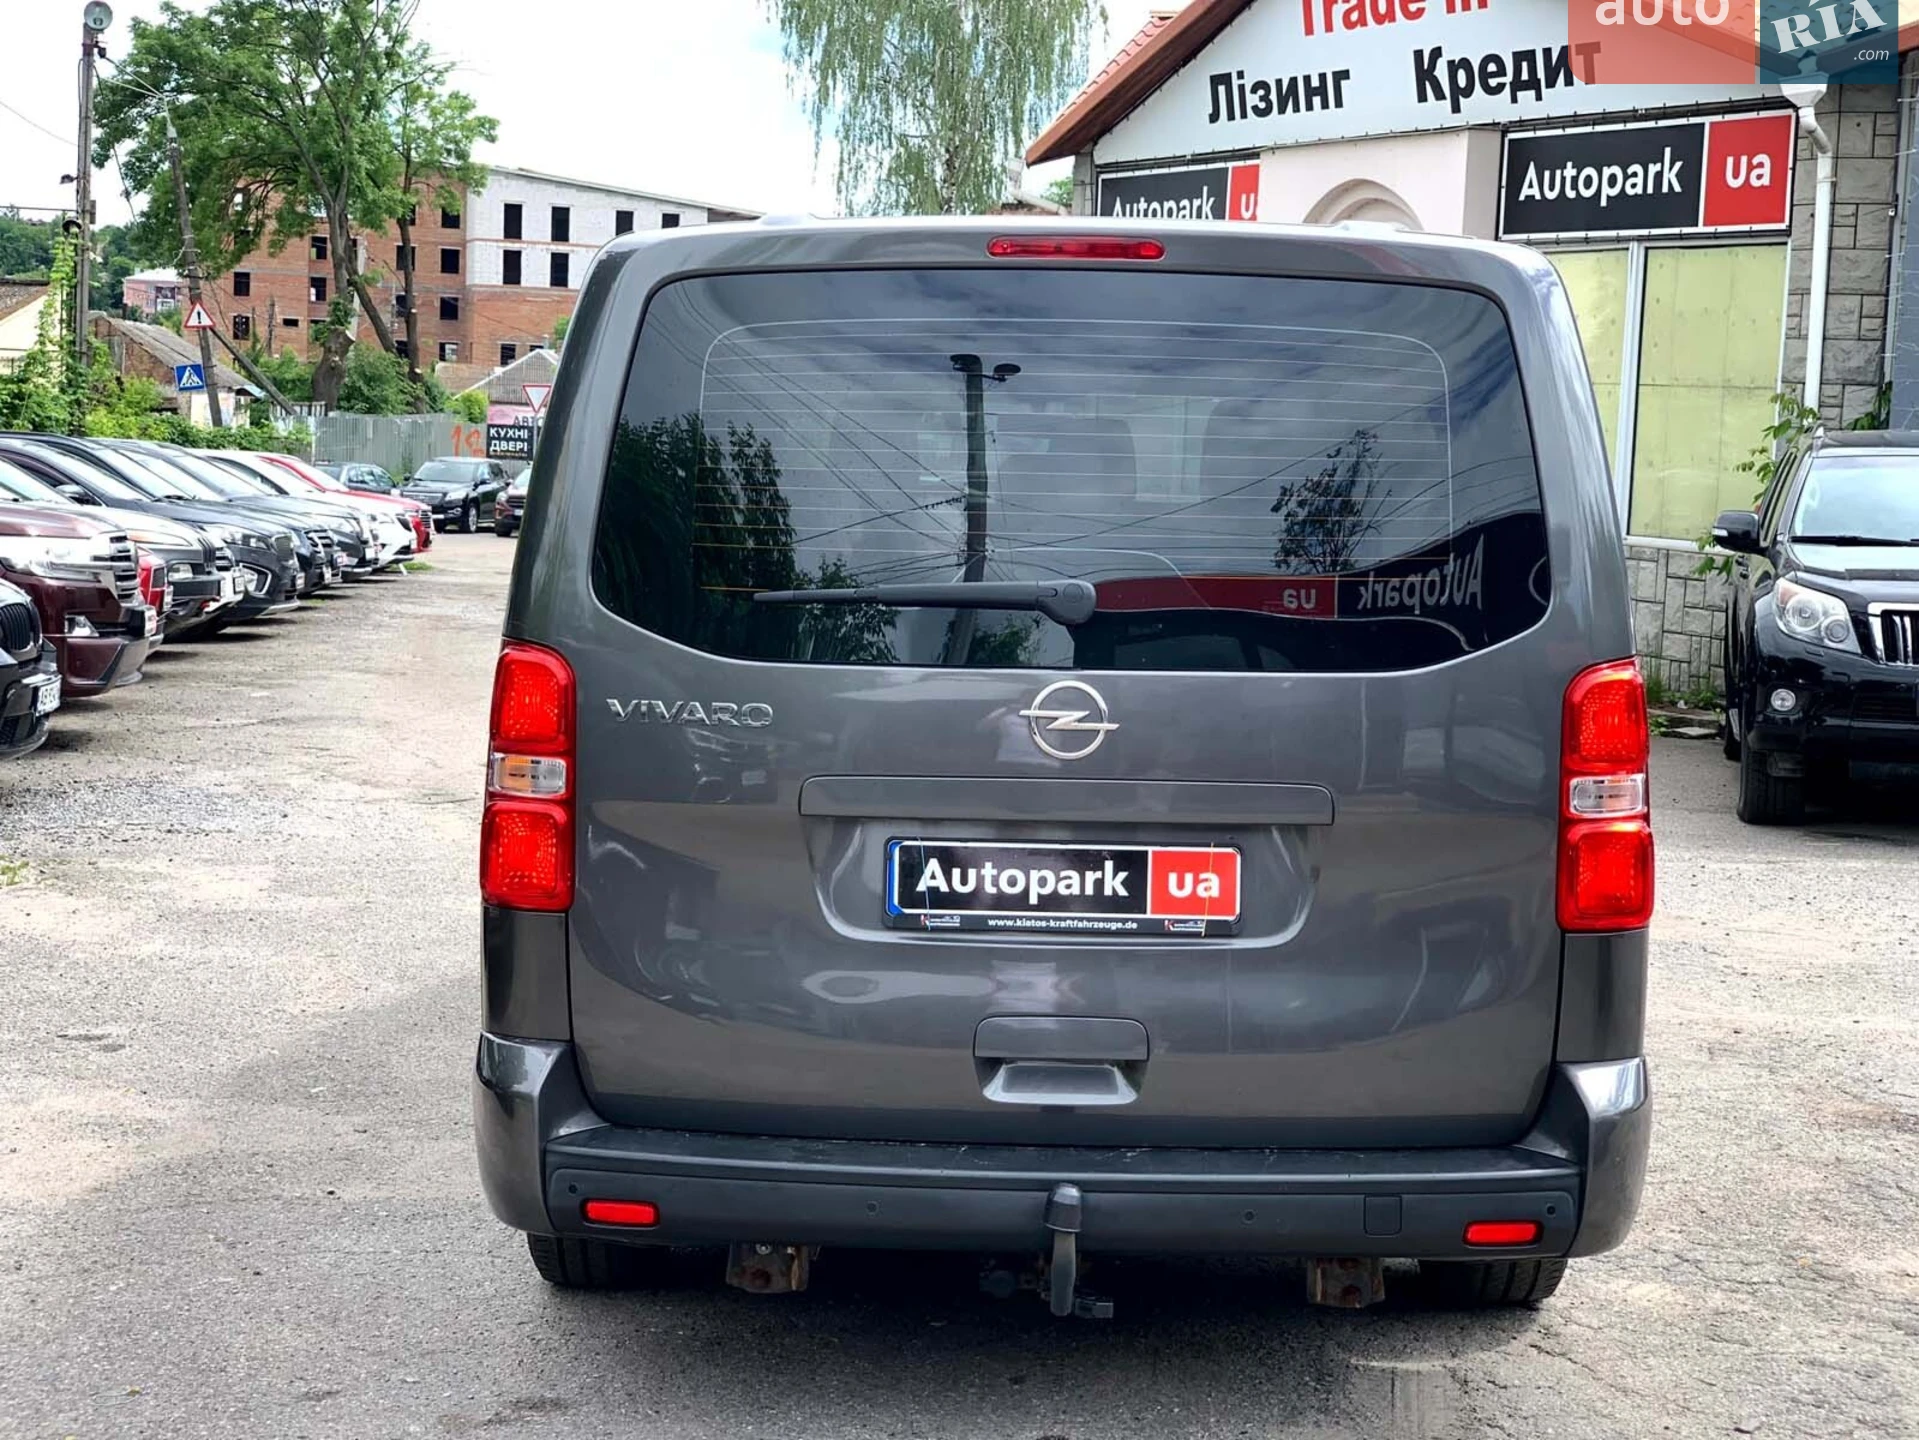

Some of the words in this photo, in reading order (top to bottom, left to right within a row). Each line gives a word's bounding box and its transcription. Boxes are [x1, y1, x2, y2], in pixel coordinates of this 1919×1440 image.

[1208, 68, 1351, 124] Лізинг
[1412, 41, 1602, 114] Кредит
[1517, 147, 1684, 207] Autopark
[1725, 152, 1772, 188] ua
[490, 427, 528, 439] КУХНІ
[490, 440, 528, 452] ДВЕРІ
[606, 699, 774, 727] VIVARO
[916, 857, 1130, 905] Autopark
[1167, 872, 1220, 898] ua
